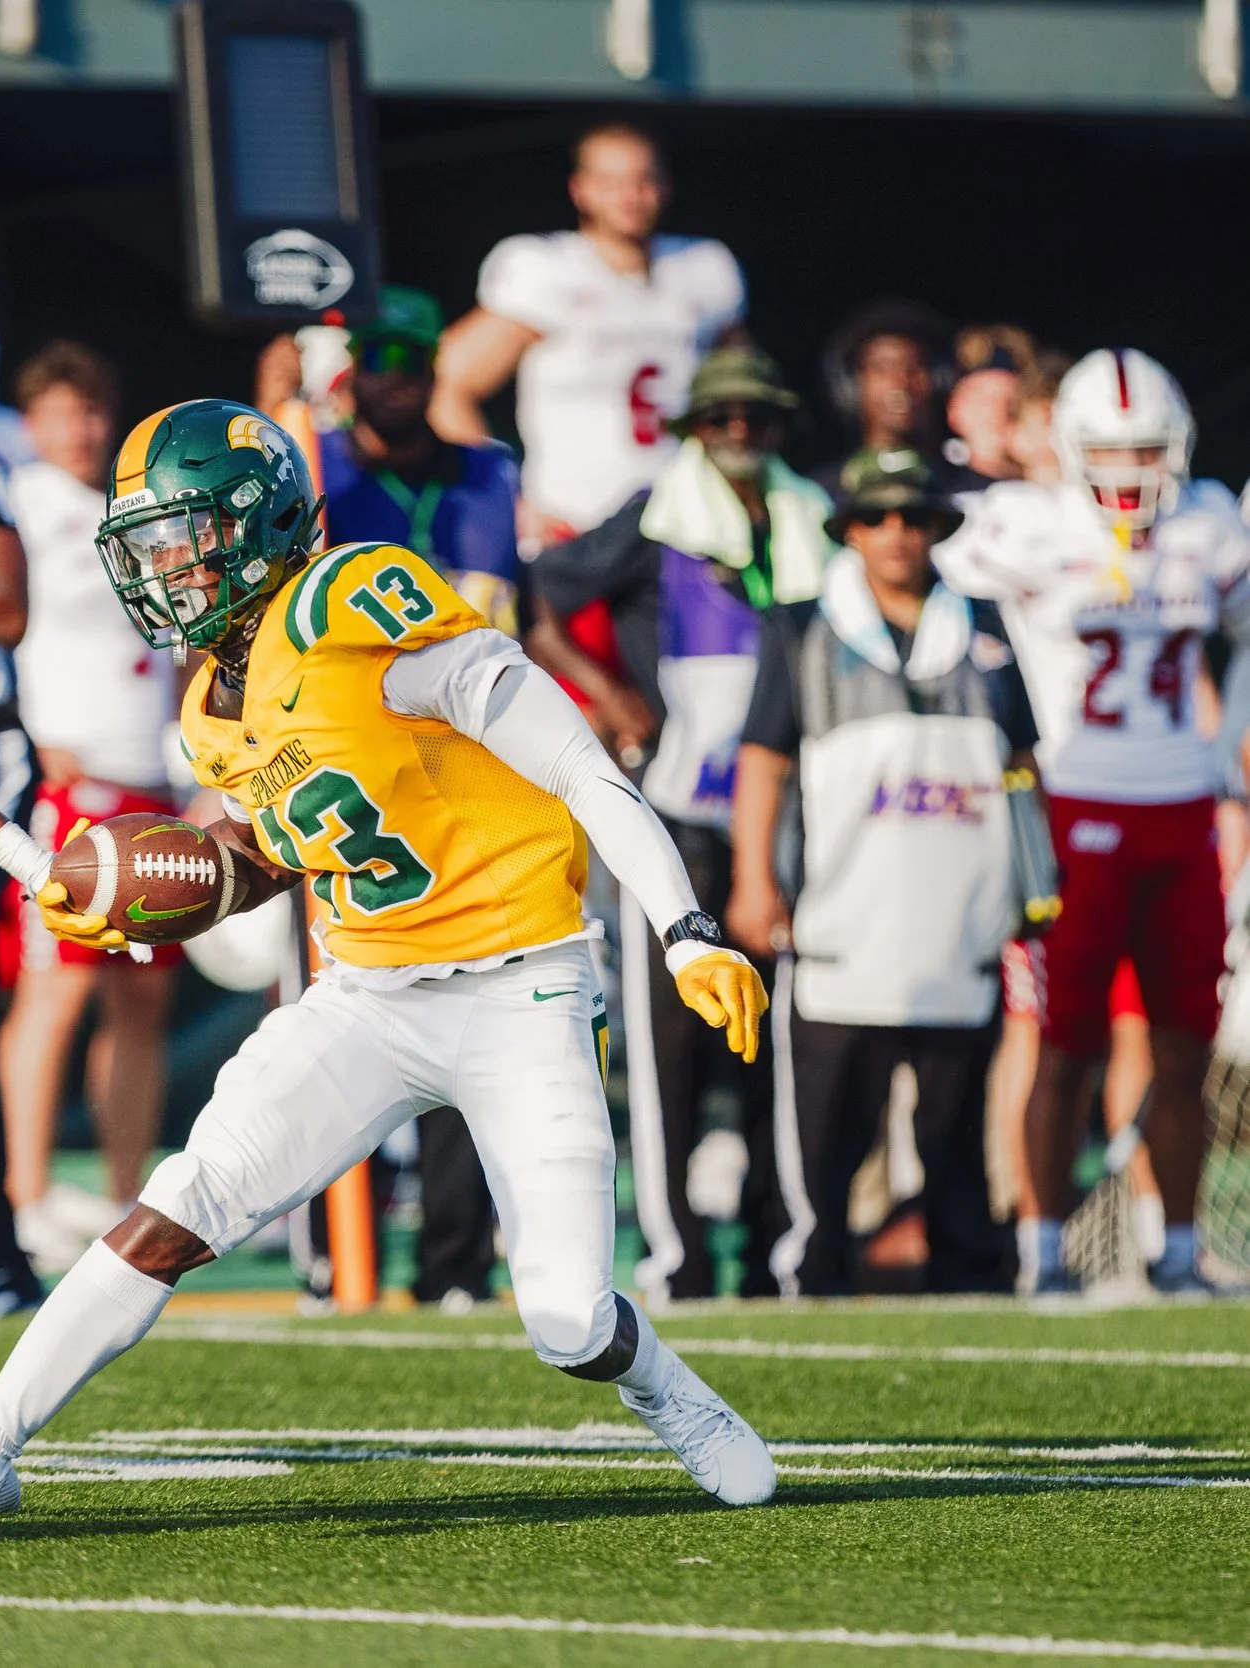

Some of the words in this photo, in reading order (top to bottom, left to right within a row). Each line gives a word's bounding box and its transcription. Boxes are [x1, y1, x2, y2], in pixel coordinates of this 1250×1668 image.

[111, 494, 146, 515] SPARTANS
[344, 563, 436, 644] 13
[250, 738, 312, 807] SPARTANS
[255, 765, 437, 924] 13
